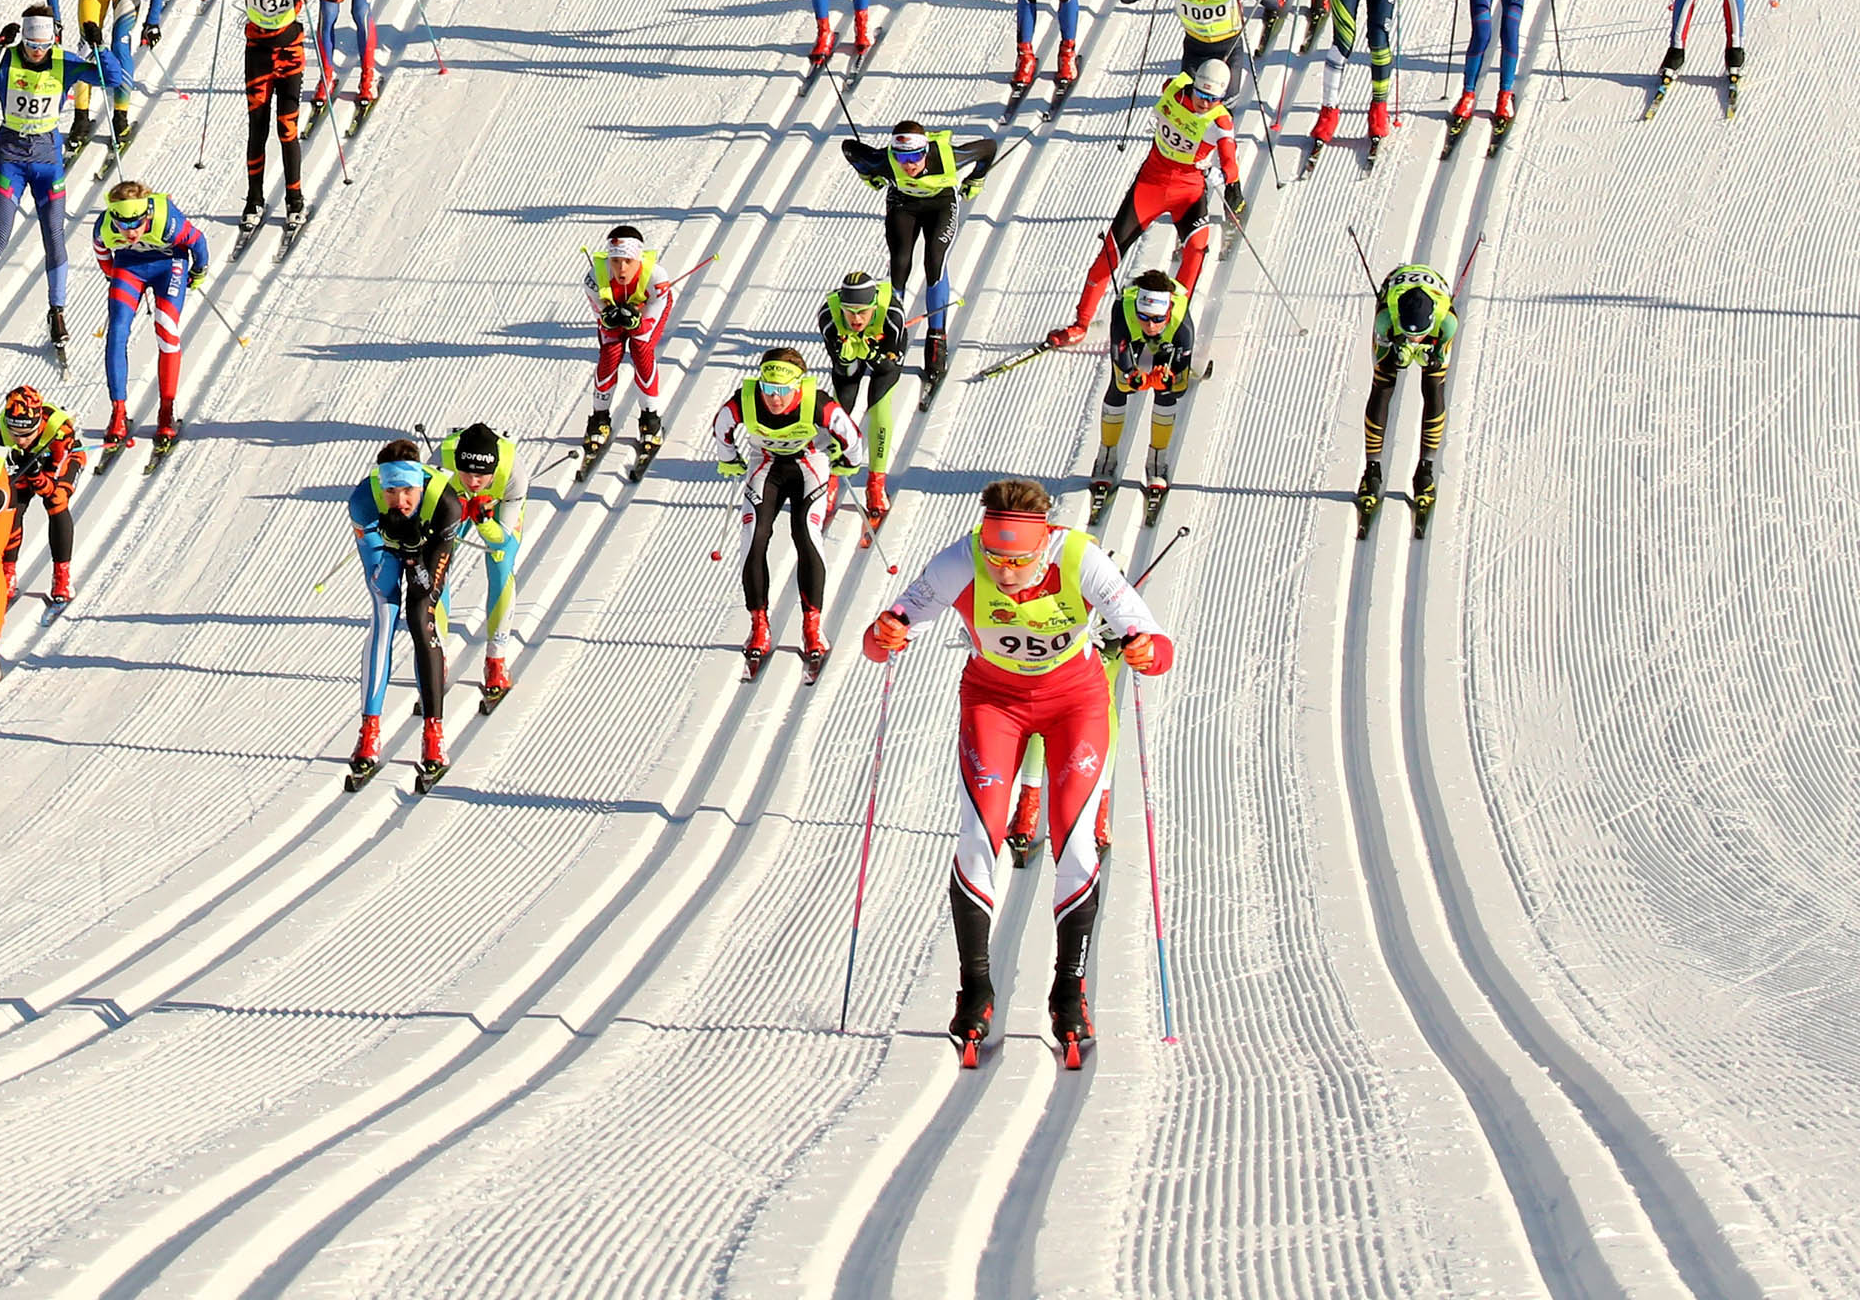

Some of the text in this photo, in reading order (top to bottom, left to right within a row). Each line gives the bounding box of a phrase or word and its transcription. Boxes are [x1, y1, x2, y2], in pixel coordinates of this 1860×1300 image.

[1182, 3, 1226, 20] 1000
[16, 96, 51, 114] 987
[461, 451, 495, 463] gorenje
[999, 631, 1072, 658] 950
